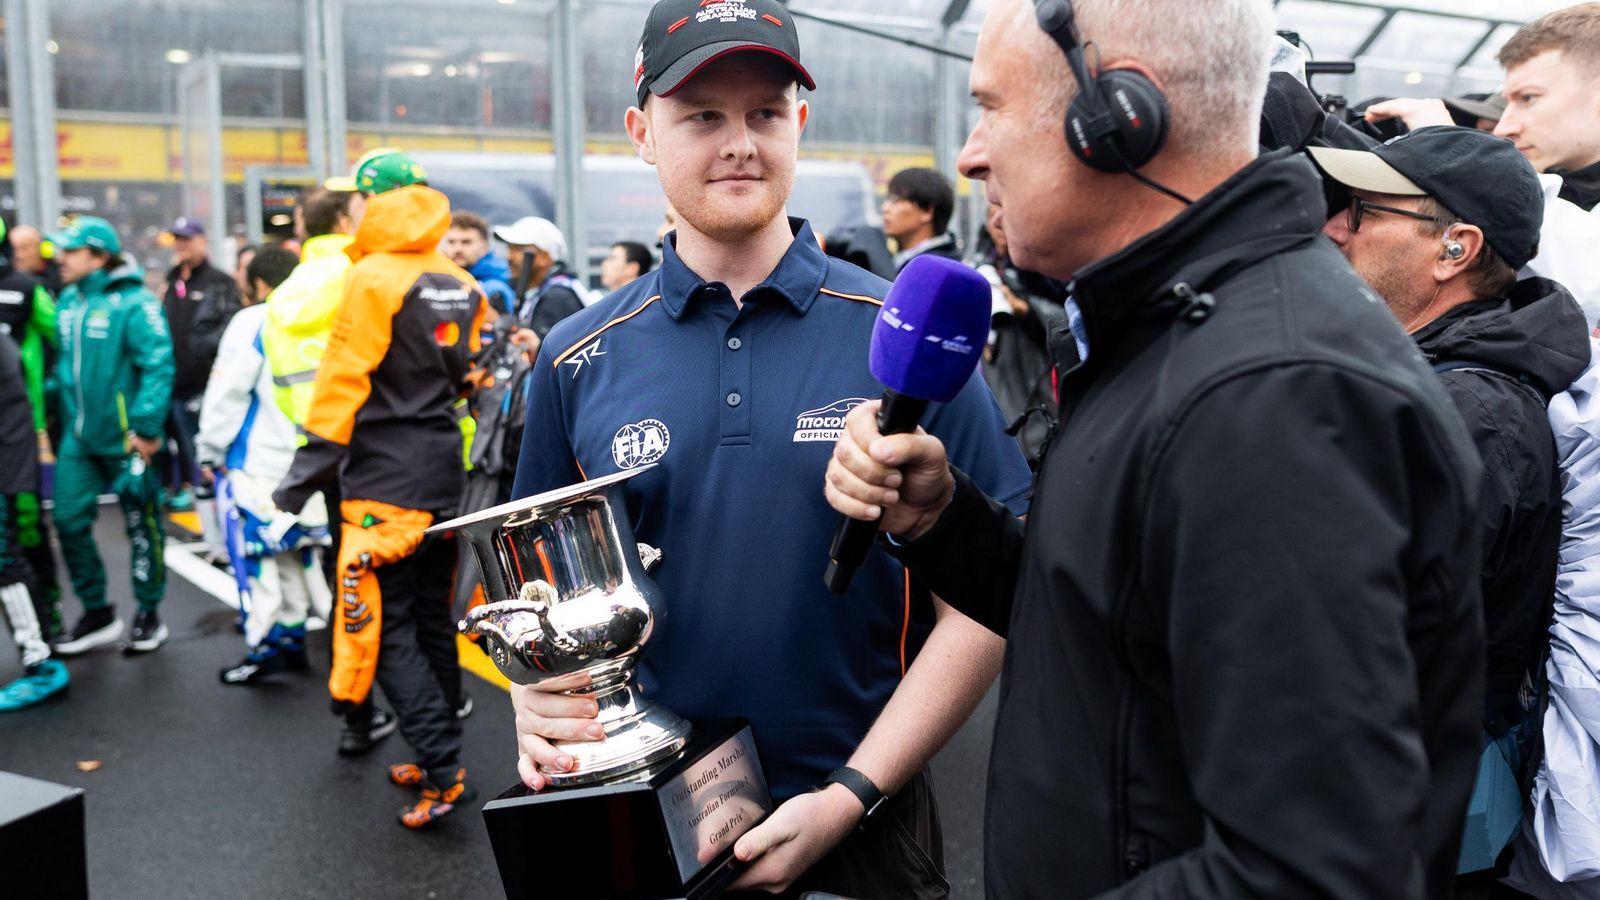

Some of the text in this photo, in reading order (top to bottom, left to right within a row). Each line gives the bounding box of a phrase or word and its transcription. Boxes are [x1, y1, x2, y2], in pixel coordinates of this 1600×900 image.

[695, 6, 757, 19] AUSTRALIAN
[698, 11, 757, 22] GRAND PRIX
[672, 744, 747, 807] Outstanding Marshal
[687, 799, 720, 831] Australian
[719, 779, 745, 804] Formula
[709, 813, 743, 845] Grand Prix
